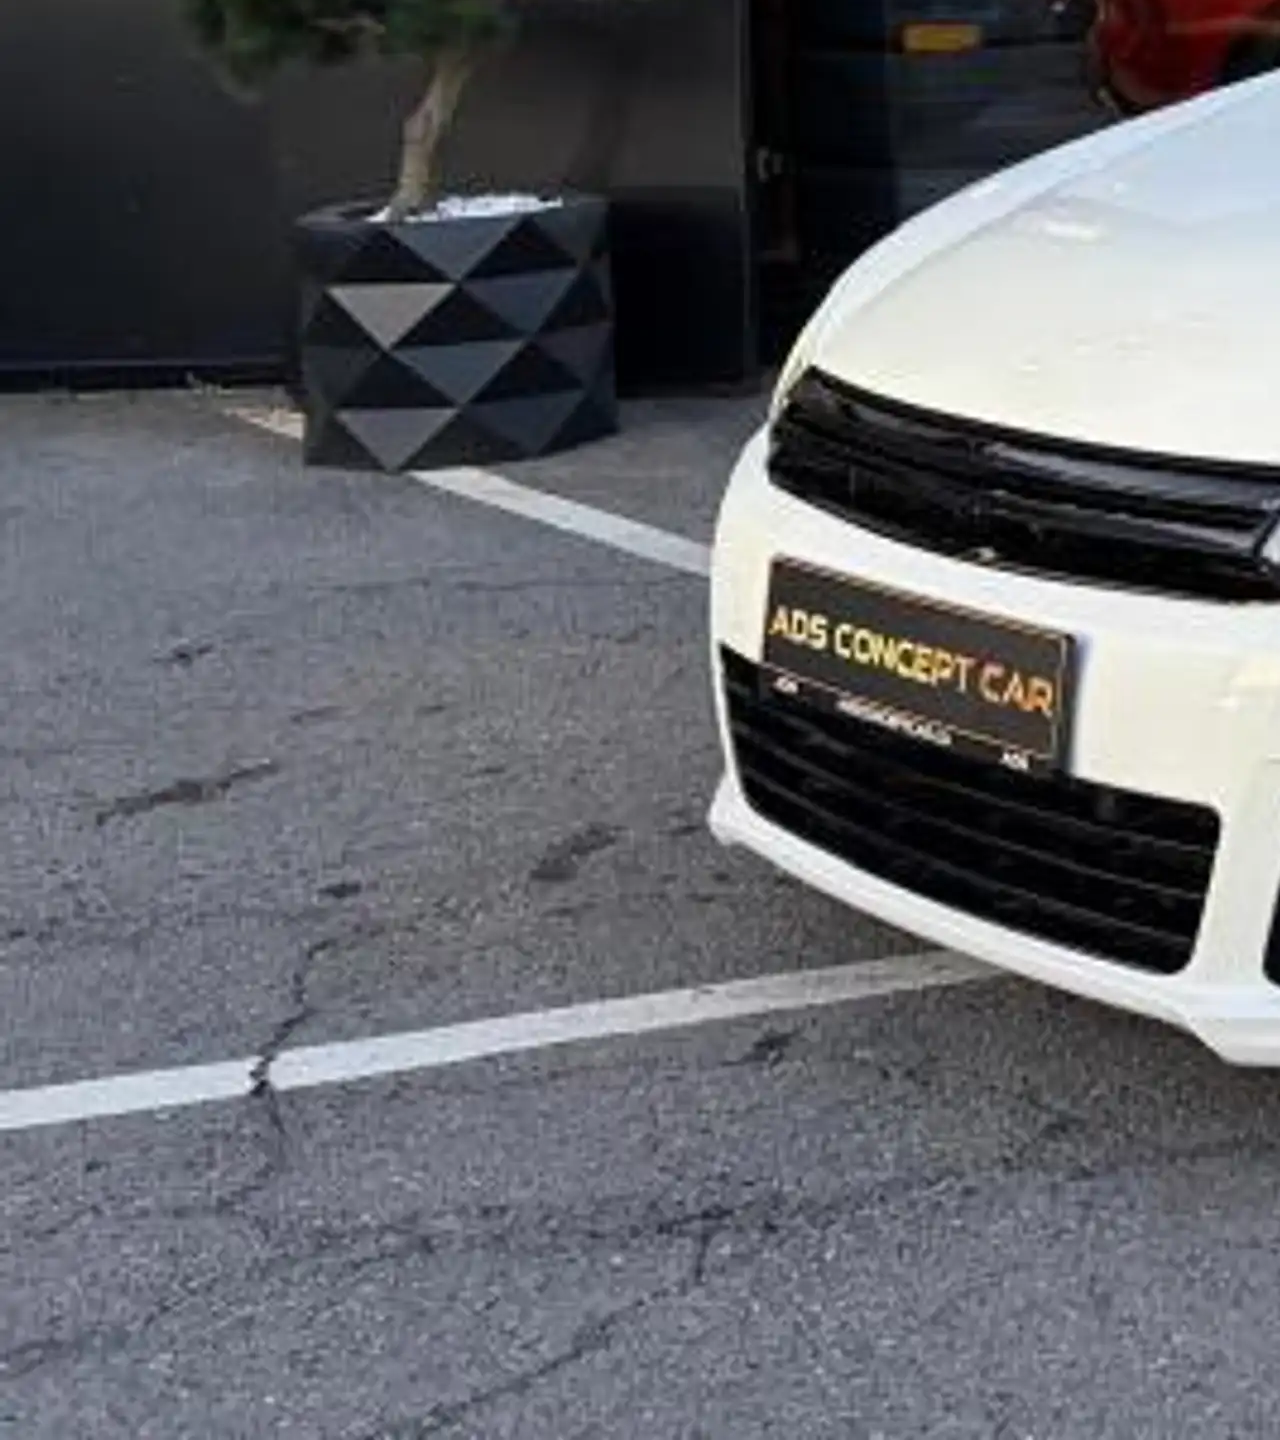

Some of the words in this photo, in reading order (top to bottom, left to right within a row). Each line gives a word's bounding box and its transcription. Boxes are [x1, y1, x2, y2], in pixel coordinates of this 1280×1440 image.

[769, 605, 828, 650] ADS
[834, 622, 974, 694] CONCEPT
[979, 664, 1054, 718] CAR
